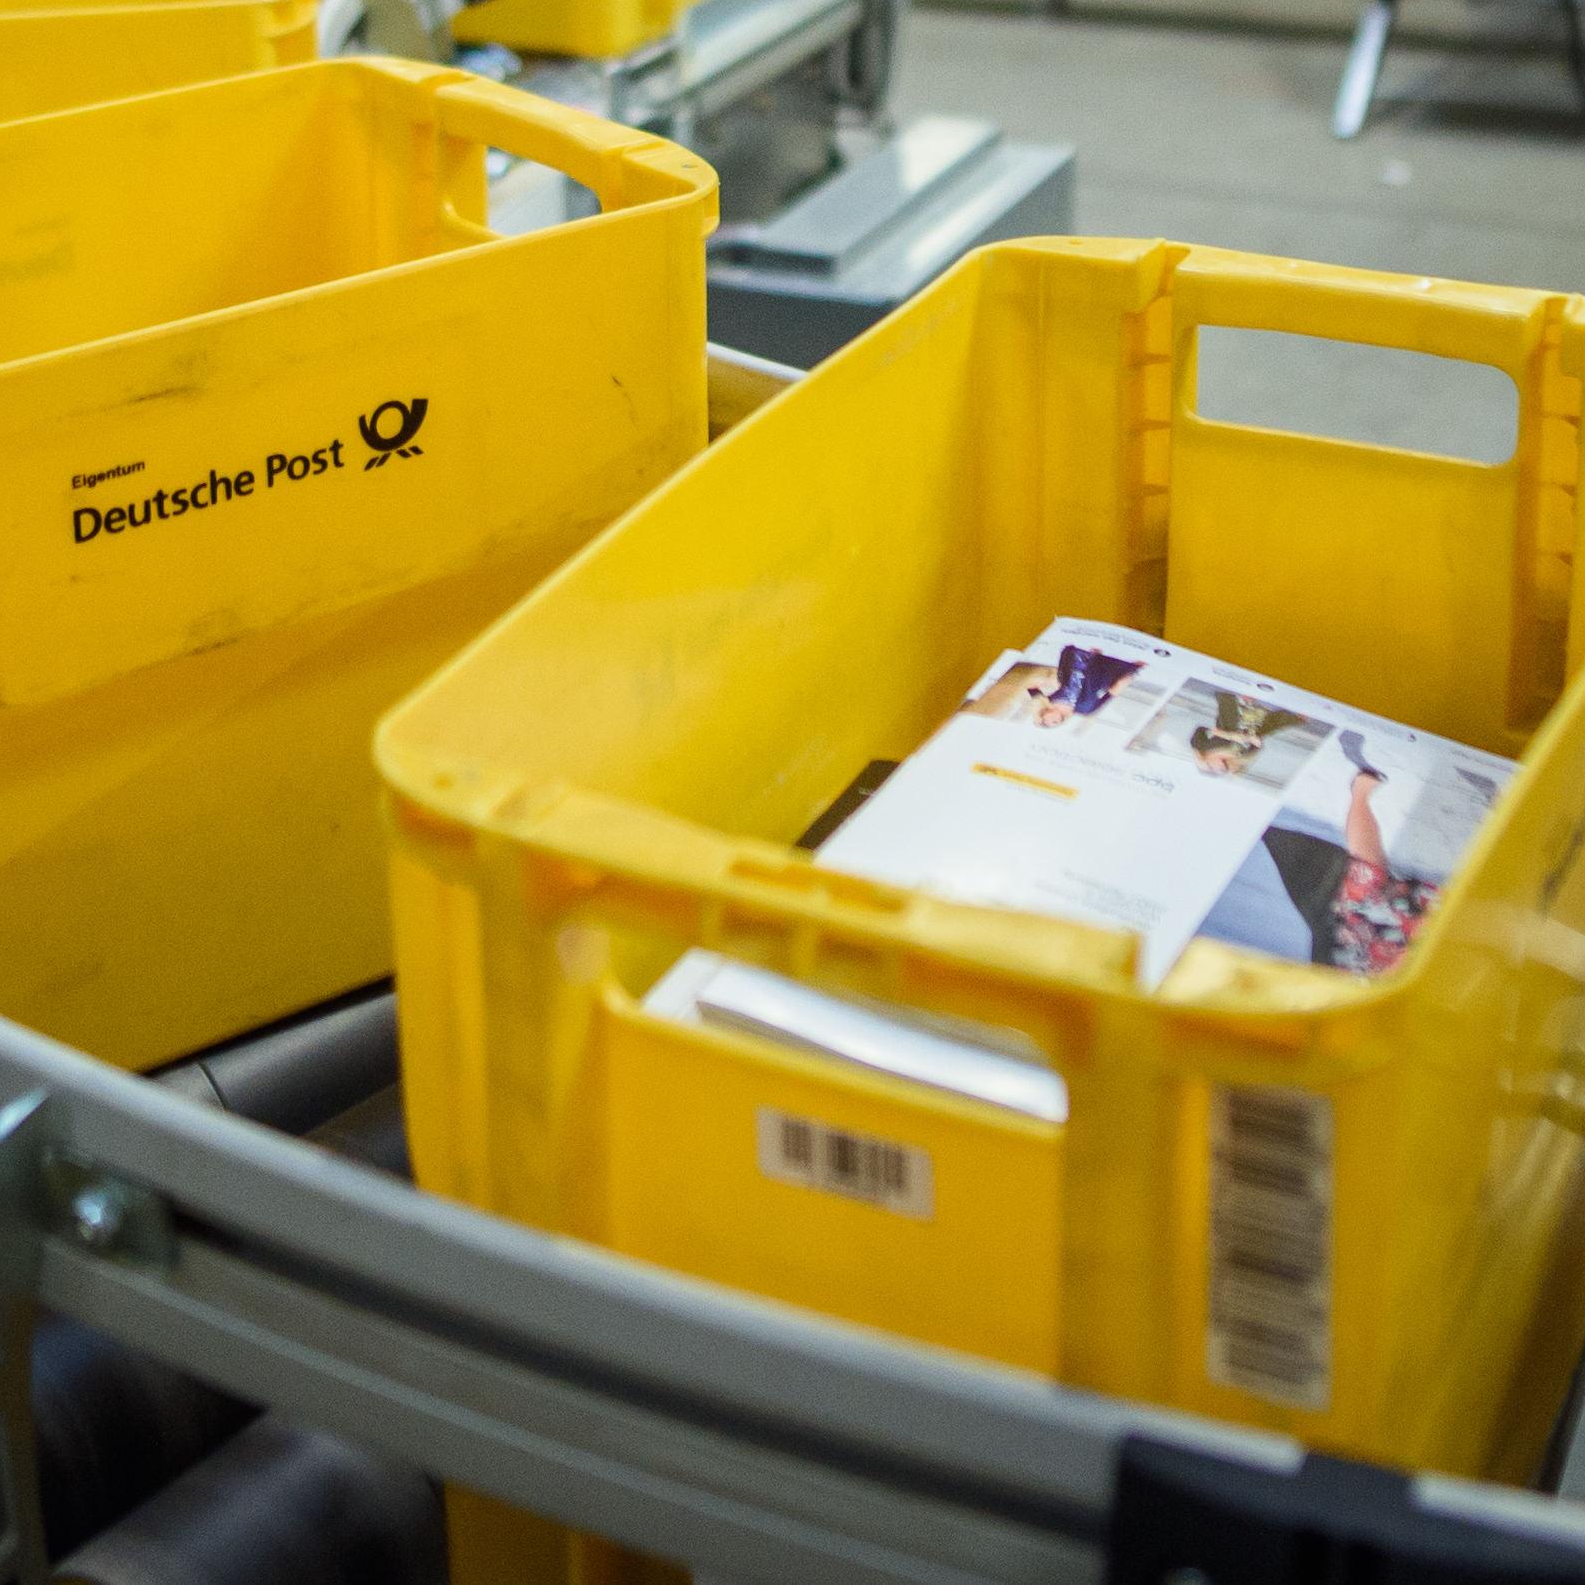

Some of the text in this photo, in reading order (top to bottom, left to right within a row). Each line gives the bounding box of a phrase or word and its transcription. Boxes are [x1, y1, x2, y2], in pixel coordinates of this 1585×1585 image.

[71, 461, 145, 490] Eigentum
[72, 439, 345, 544] Deutsche Post
